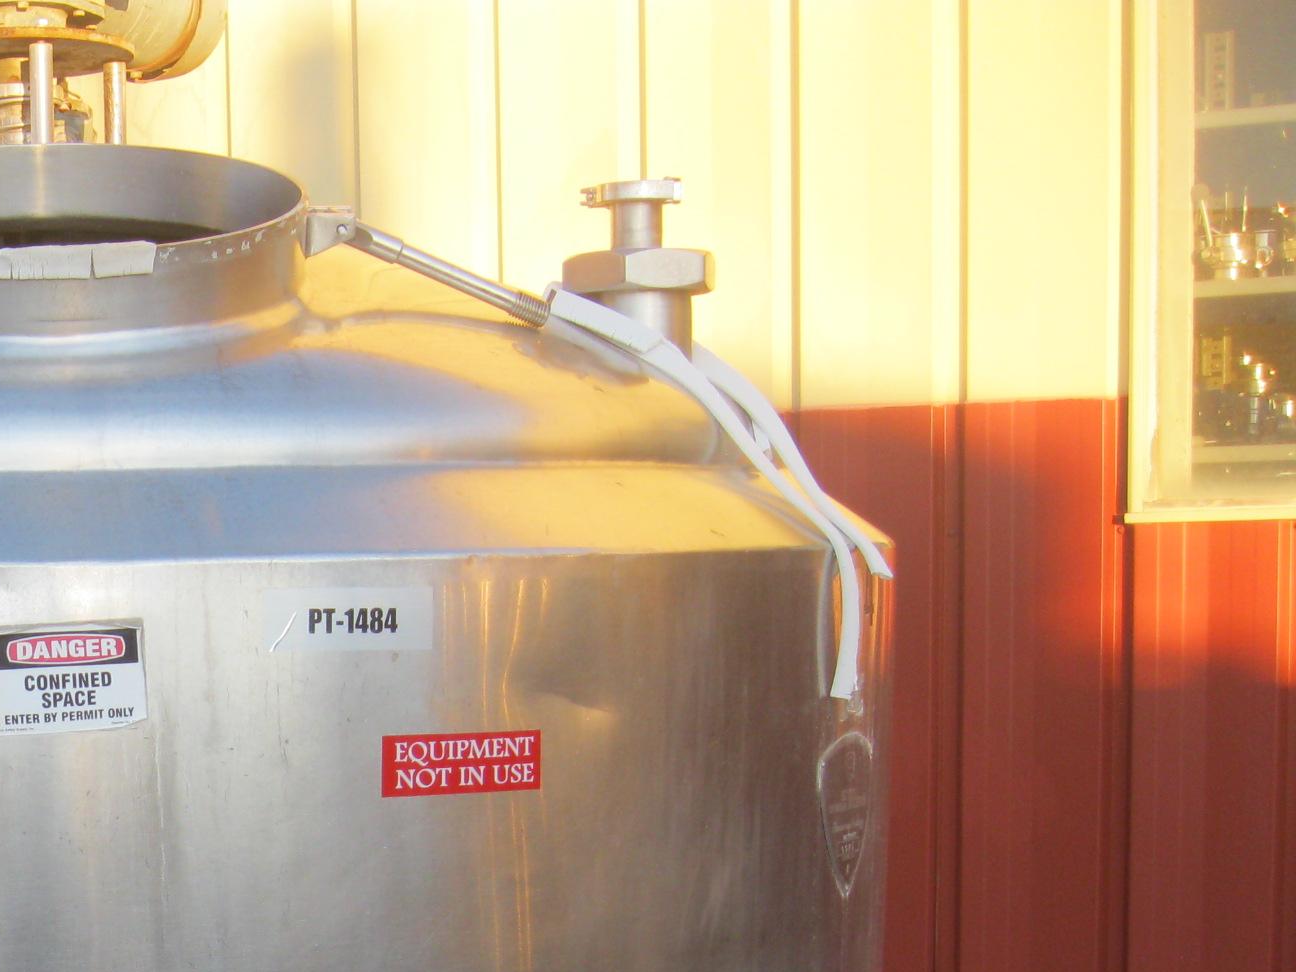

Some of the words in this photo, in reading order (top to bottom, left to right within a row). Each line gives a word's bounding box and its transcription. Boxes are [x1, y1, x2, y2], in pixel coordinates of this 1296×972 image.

[308, 607, 398, 634] PT-1484
[16, 638, 118, 661] DANGER
[24, 671, 112, 692] CONFINED
[41, 690, 97, 709] SPACE
[4, 714, 40, 725] ENTER
[44, 712, 57, 723] BY
[61, 709, 105, 722] PERMIT
[108, 707, 135, 719] ONLY
[394, 736, 534, 766] EQUIPMENT
[395, 767, 452, 790] NOT
[458, 765, 486, 786] IN
[492, 763, 534, 785] USE
